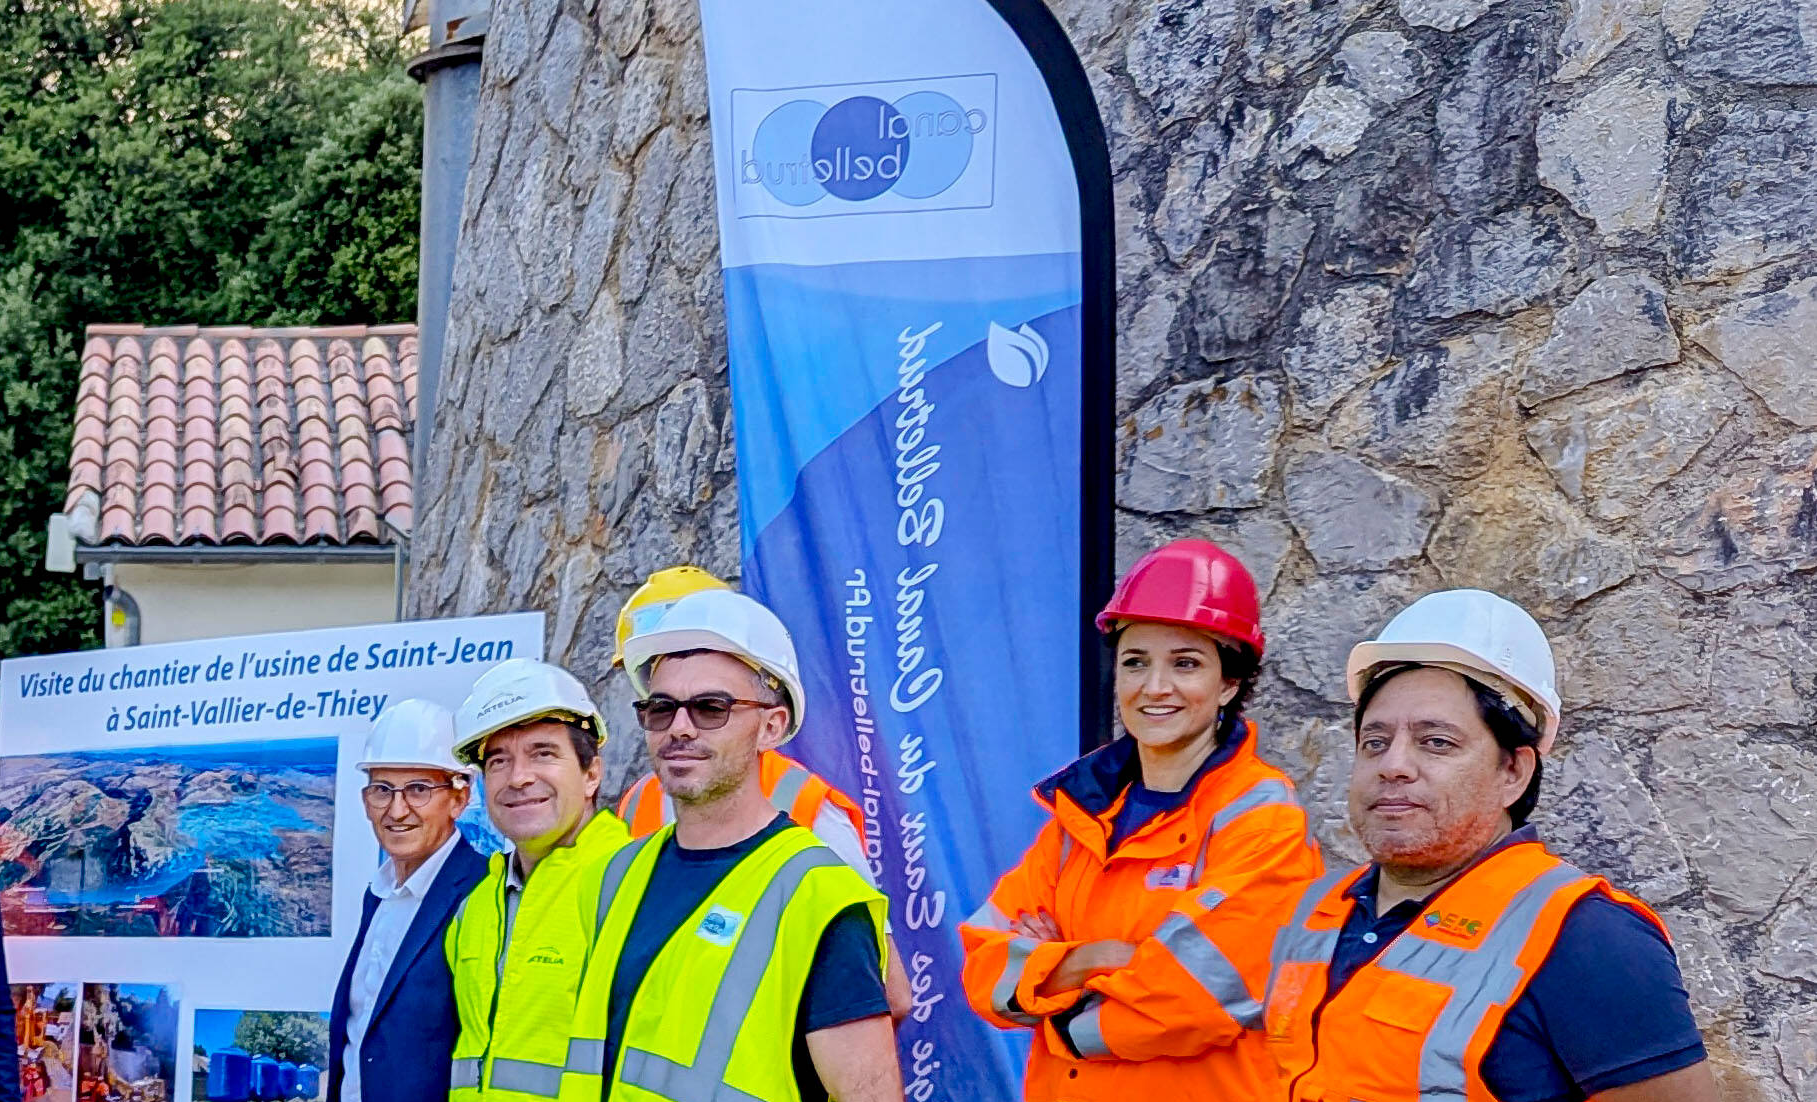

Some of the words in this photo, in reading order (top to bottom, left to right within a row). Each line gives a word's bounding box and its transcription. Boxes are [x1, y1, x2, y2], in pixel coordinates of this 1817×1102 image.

[19, 671, 75, 699] Visite
[78, 666, 106, 694] du
[108, 659, 202, 691] chantier
[204, 654, 234, 683] de
[327, 644, 360, 673] de
[364, 636, 514, 671] Saint-Jean
[105, 706, 120, 733] à
[123, 688, 389, 731] Saint-Vallier-de-Thiey
[476, 695, 525, 720] ARTELIA
